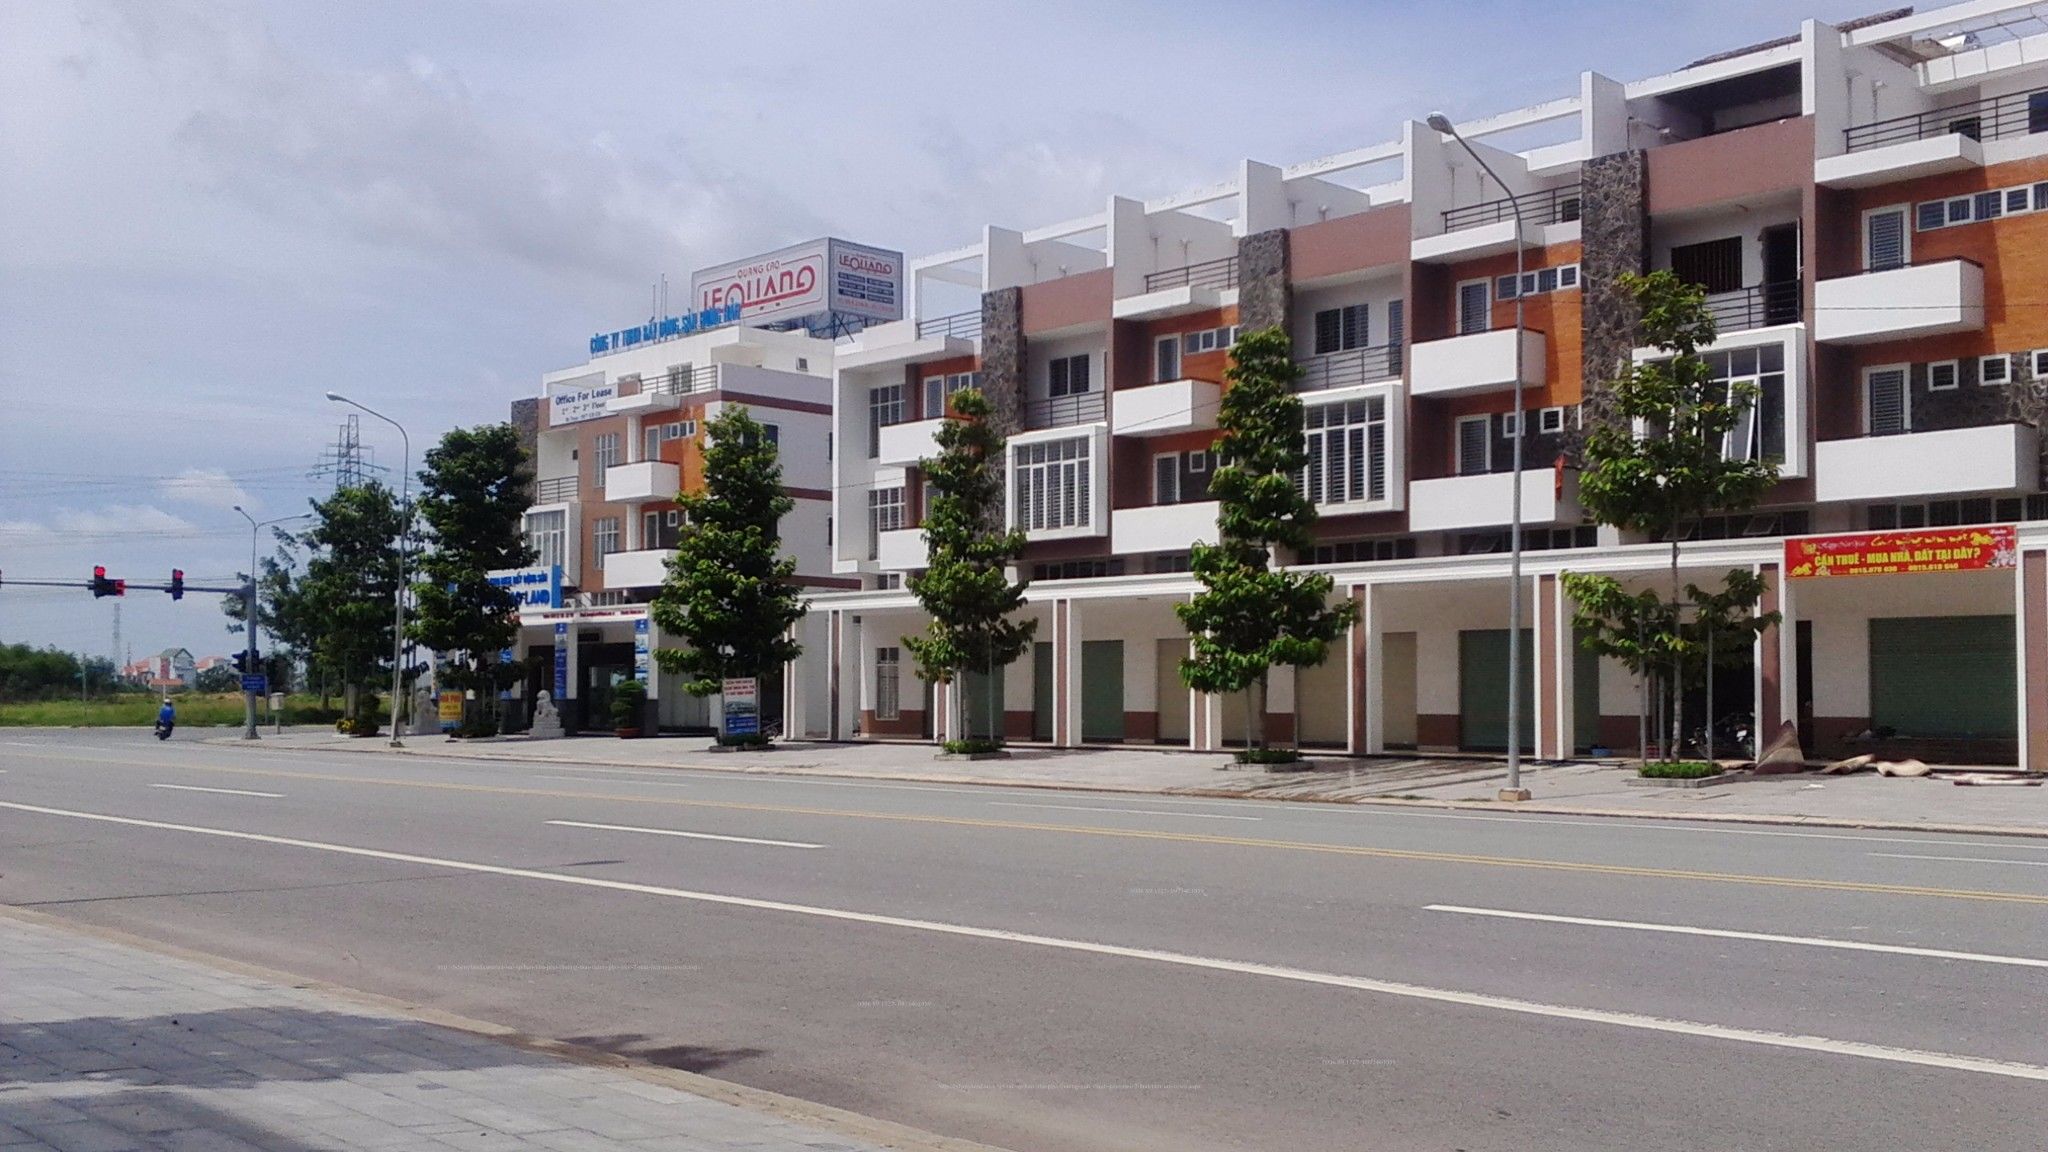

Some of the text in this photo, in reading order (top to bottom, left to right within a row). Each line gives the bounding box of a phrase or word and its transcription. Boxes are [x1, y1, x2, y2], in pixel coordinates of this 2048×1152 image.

[555, 388, 612, 405] Office For Lease
[1866, 552, 1889, 564] MUA
